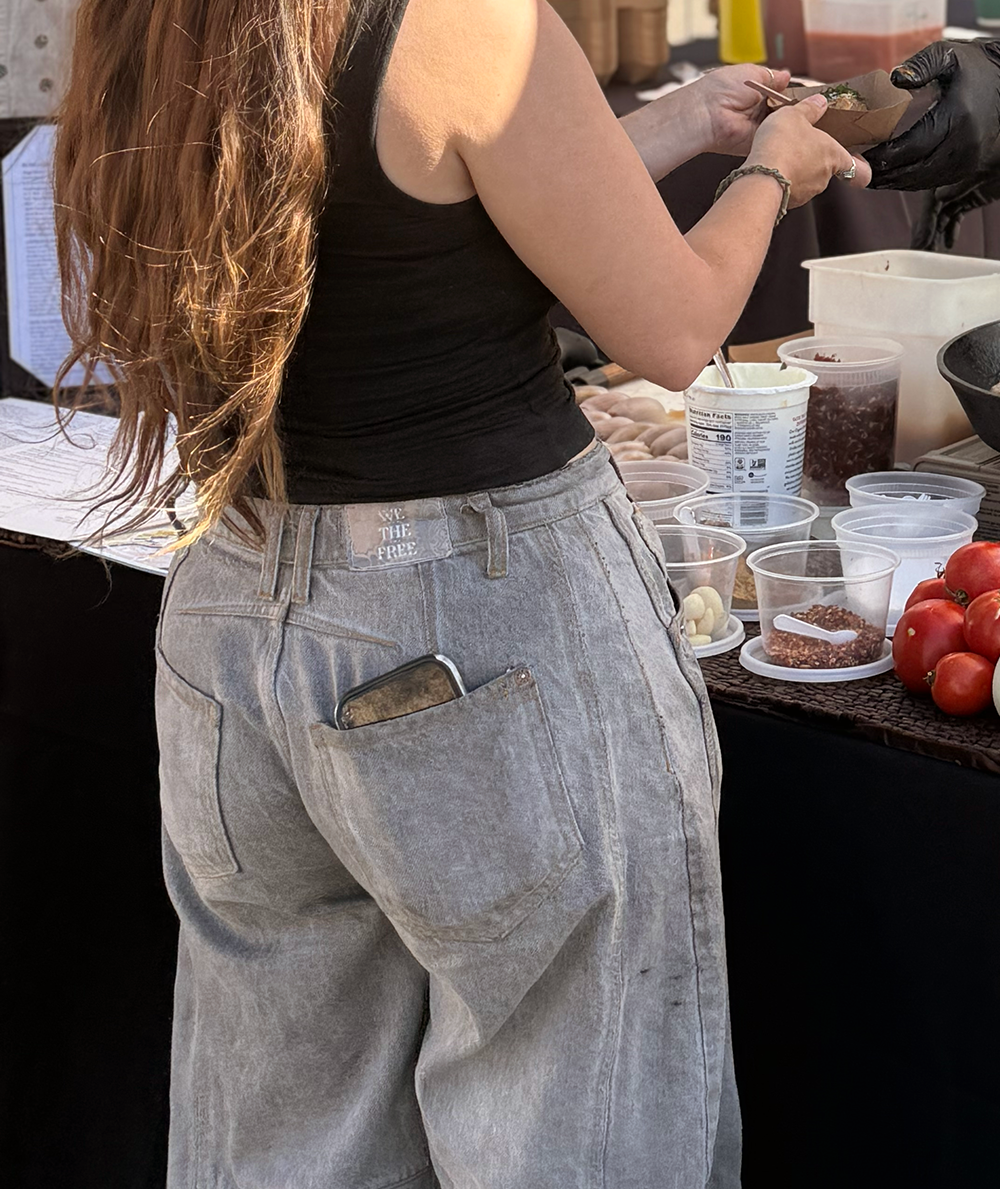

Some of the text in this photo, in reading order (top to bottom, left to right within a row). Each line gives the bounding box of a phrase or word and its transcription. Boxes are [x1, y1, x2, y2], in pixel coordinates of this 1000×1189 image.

[716, 434, 732, 442] 190
[378, 507, 405, 522] WE
[378, 523, 412, 540] THE
[377, 541, 418, 560] FREE
